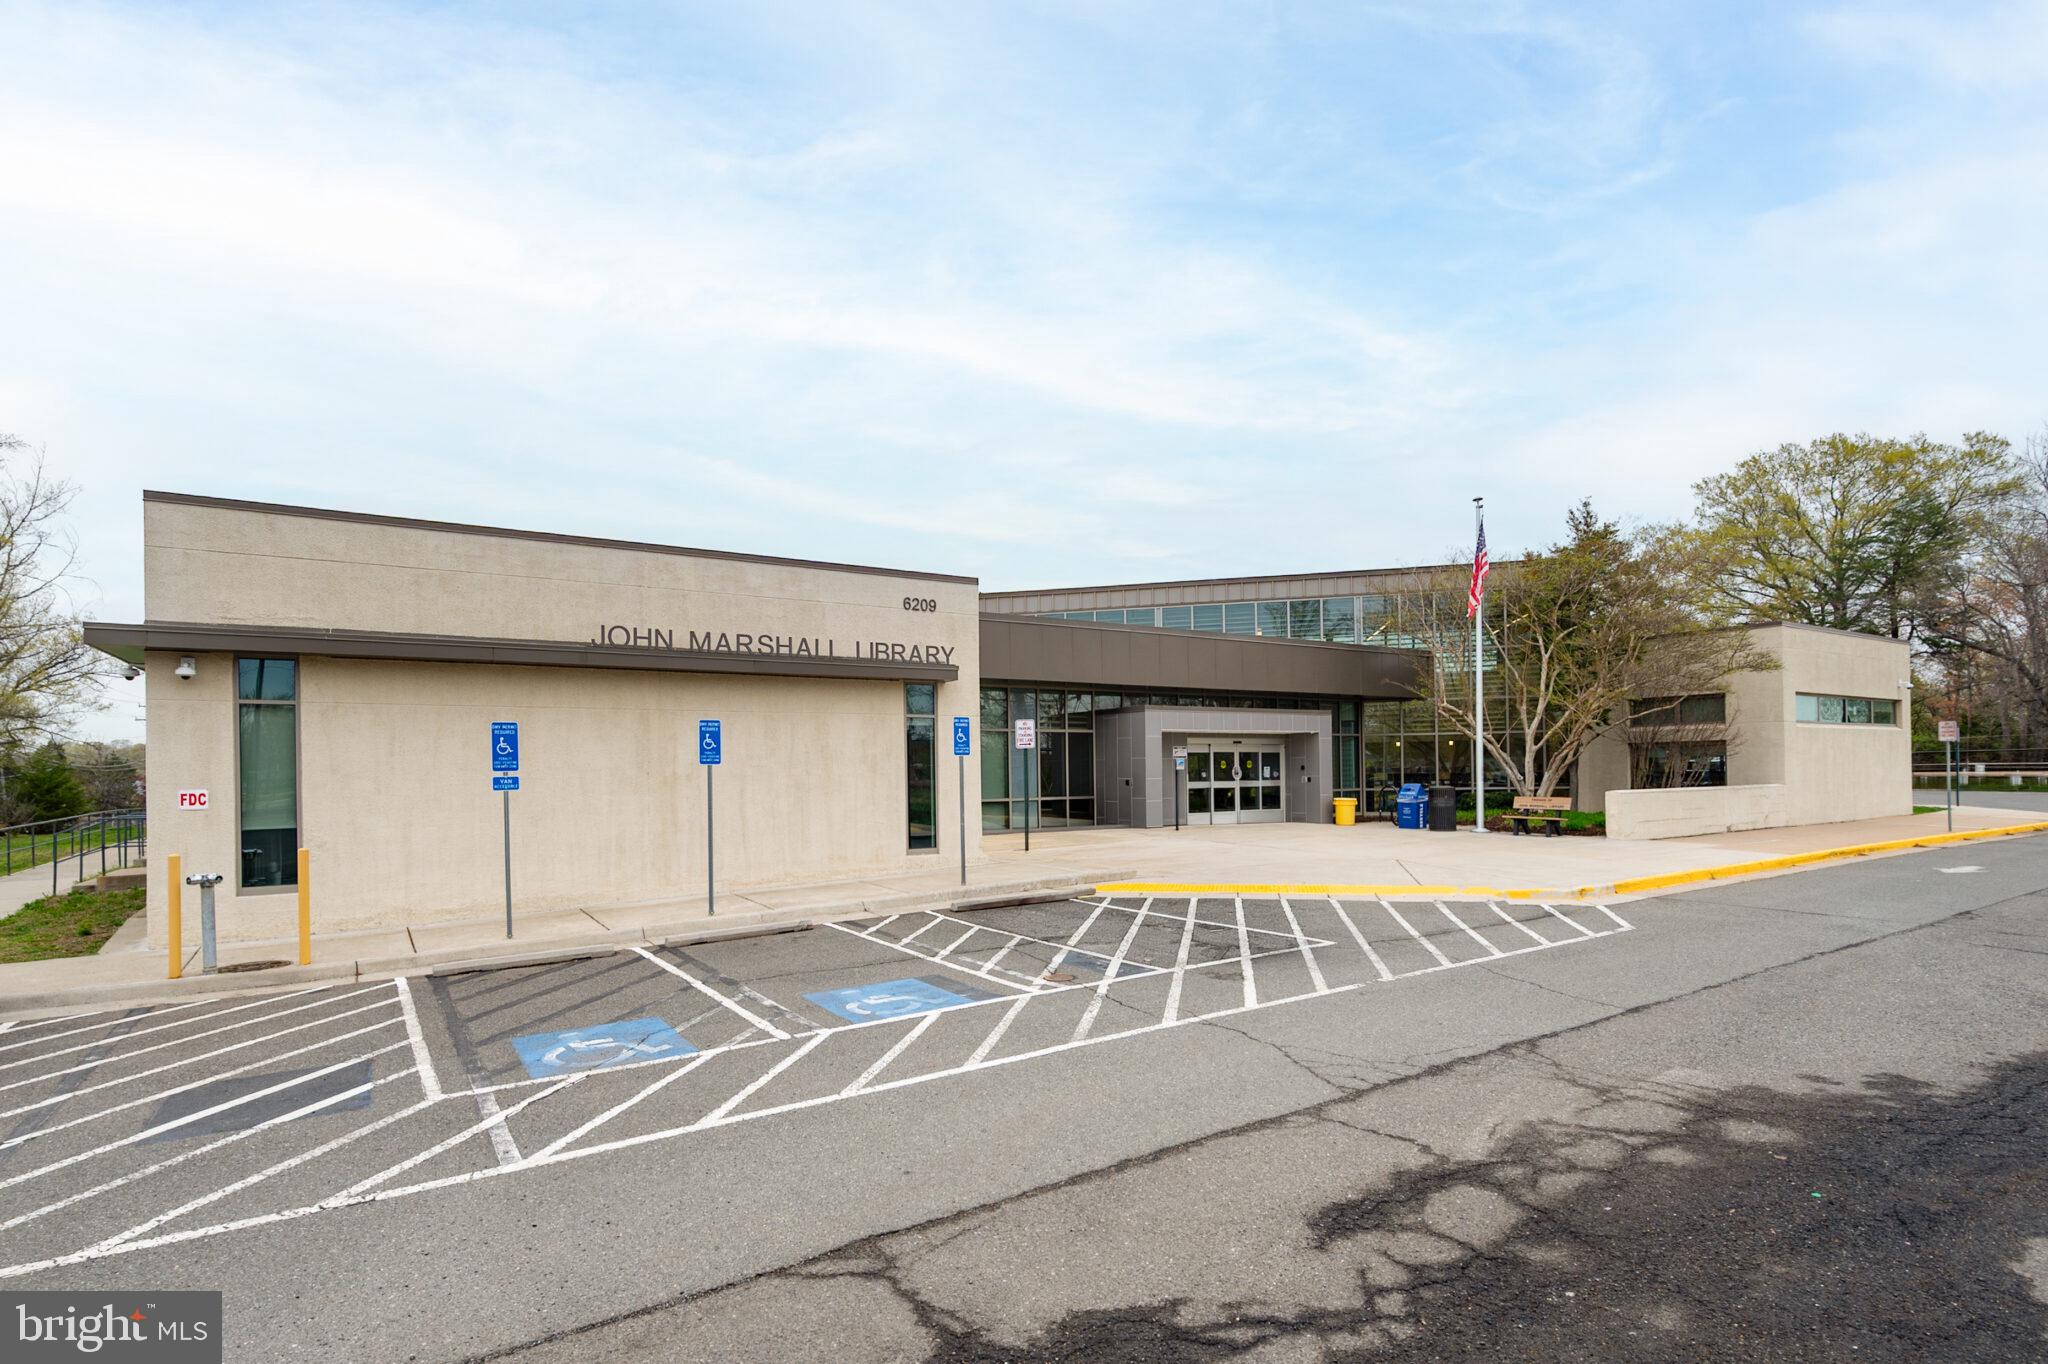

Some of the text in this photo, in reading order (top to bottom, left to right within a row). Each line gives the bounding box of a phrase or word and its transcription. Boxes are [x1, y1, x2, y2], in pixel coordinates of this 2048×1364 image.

[902, 596, 937, 612] 6209
[591, 624, 955, 665] JOHN MARSHALL LIBRARY
[180, 793, 207, 806] FDC
